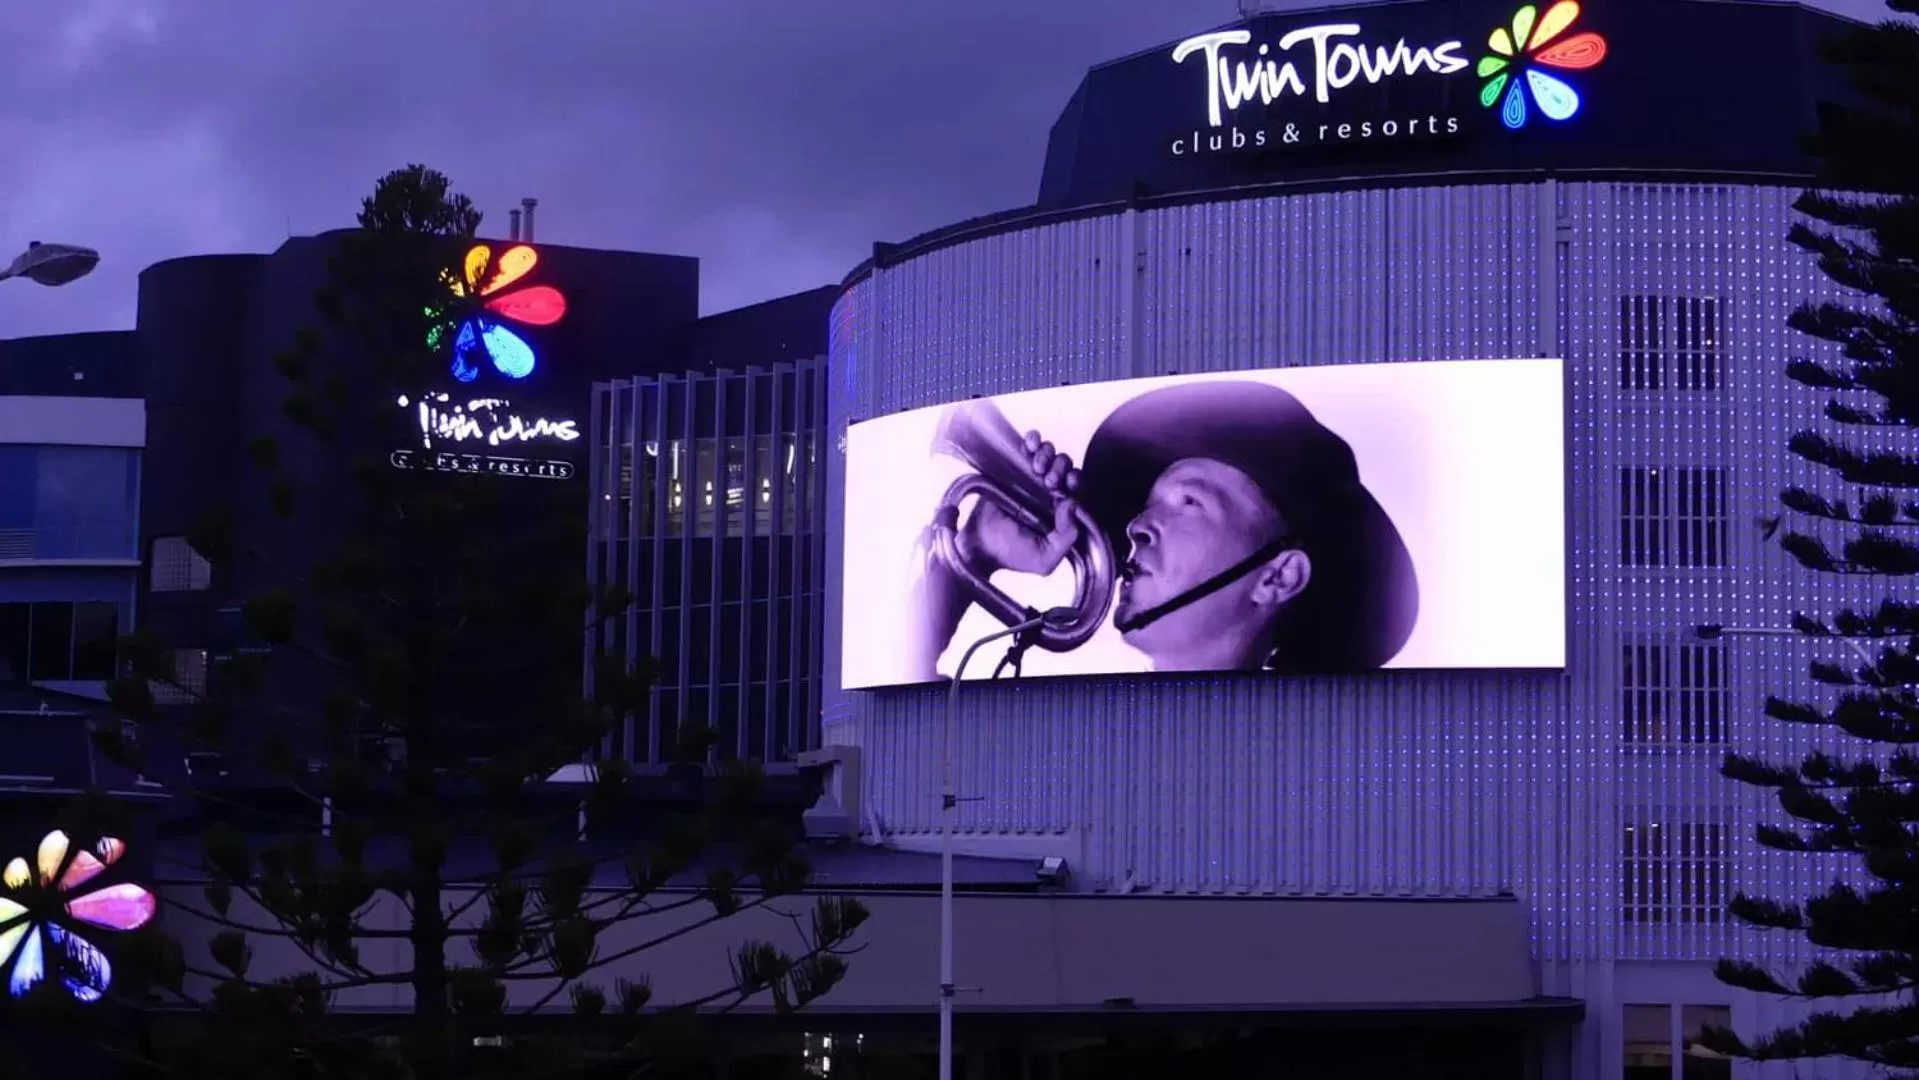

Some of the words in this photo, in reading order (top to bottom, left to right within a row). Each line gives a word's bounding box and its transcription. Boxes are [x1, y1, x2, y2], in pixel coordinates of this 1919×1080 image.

[1171, 29, 1304, 127] Twin
[1279, 23, 1470, 103] Towns
[1171, 131, 1266, 156] clubs
[1282, 122, 1301, 144] &
[1318, 114, 1460, 141] resorts
